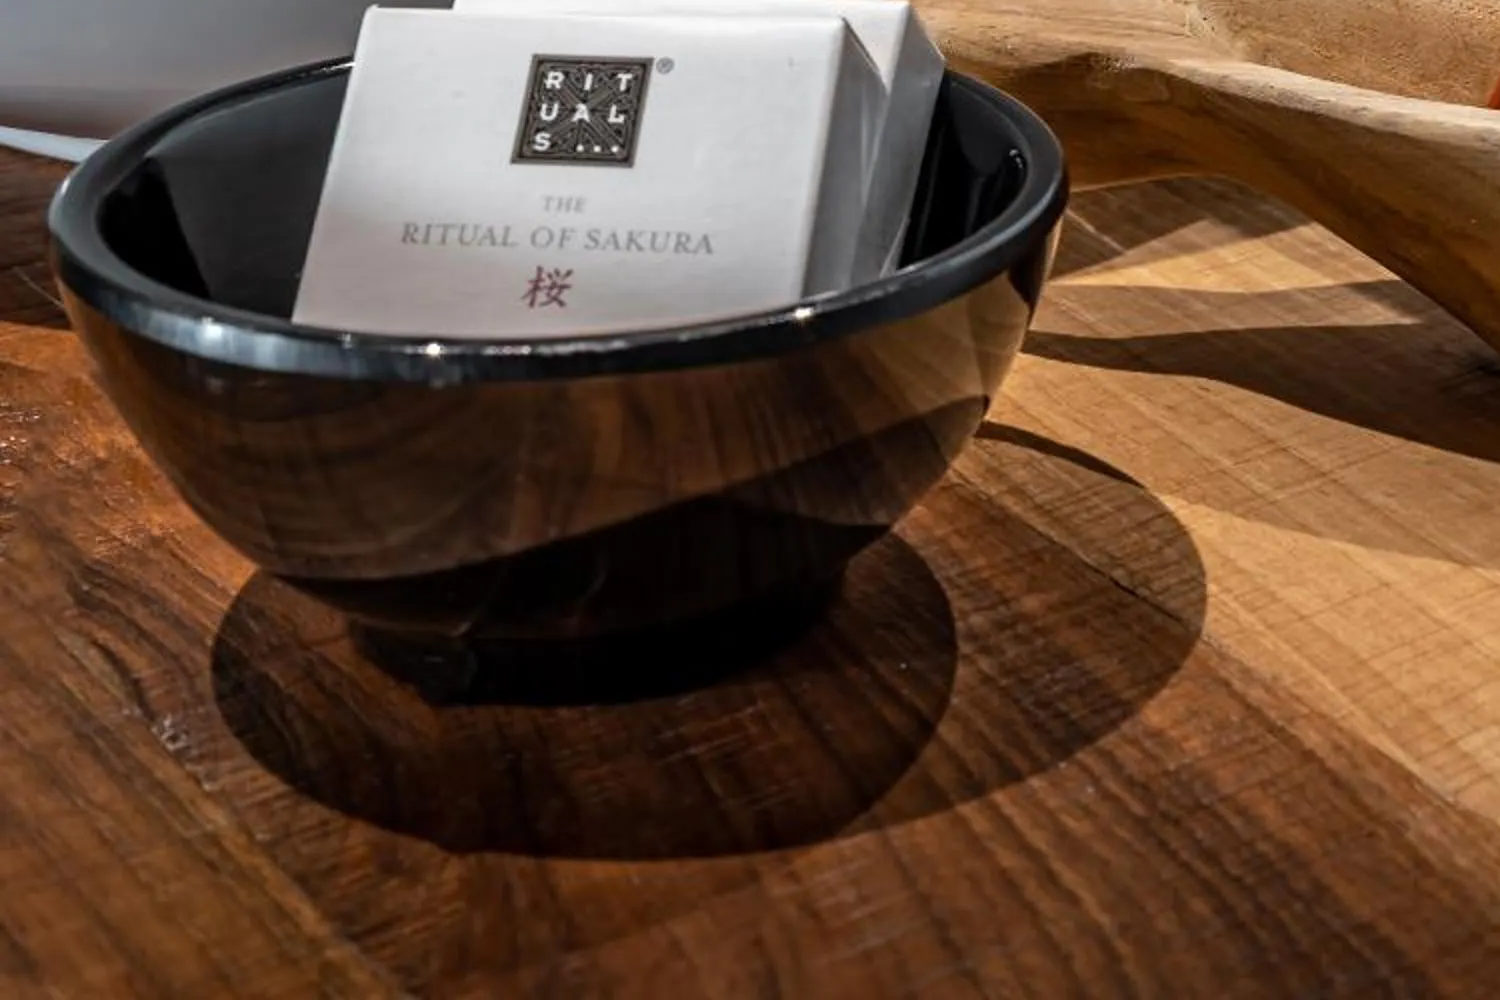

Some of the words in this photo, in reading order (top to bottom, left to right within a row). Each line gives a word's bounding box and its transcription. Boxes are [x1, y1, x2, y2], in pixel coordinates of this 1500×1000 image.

[541, 195, 588, 214] THE
[400, 221, 519, 248] RITUAL
[530, 226, 576, 250] OF
[583, 228, 715, 256] SAKURA
